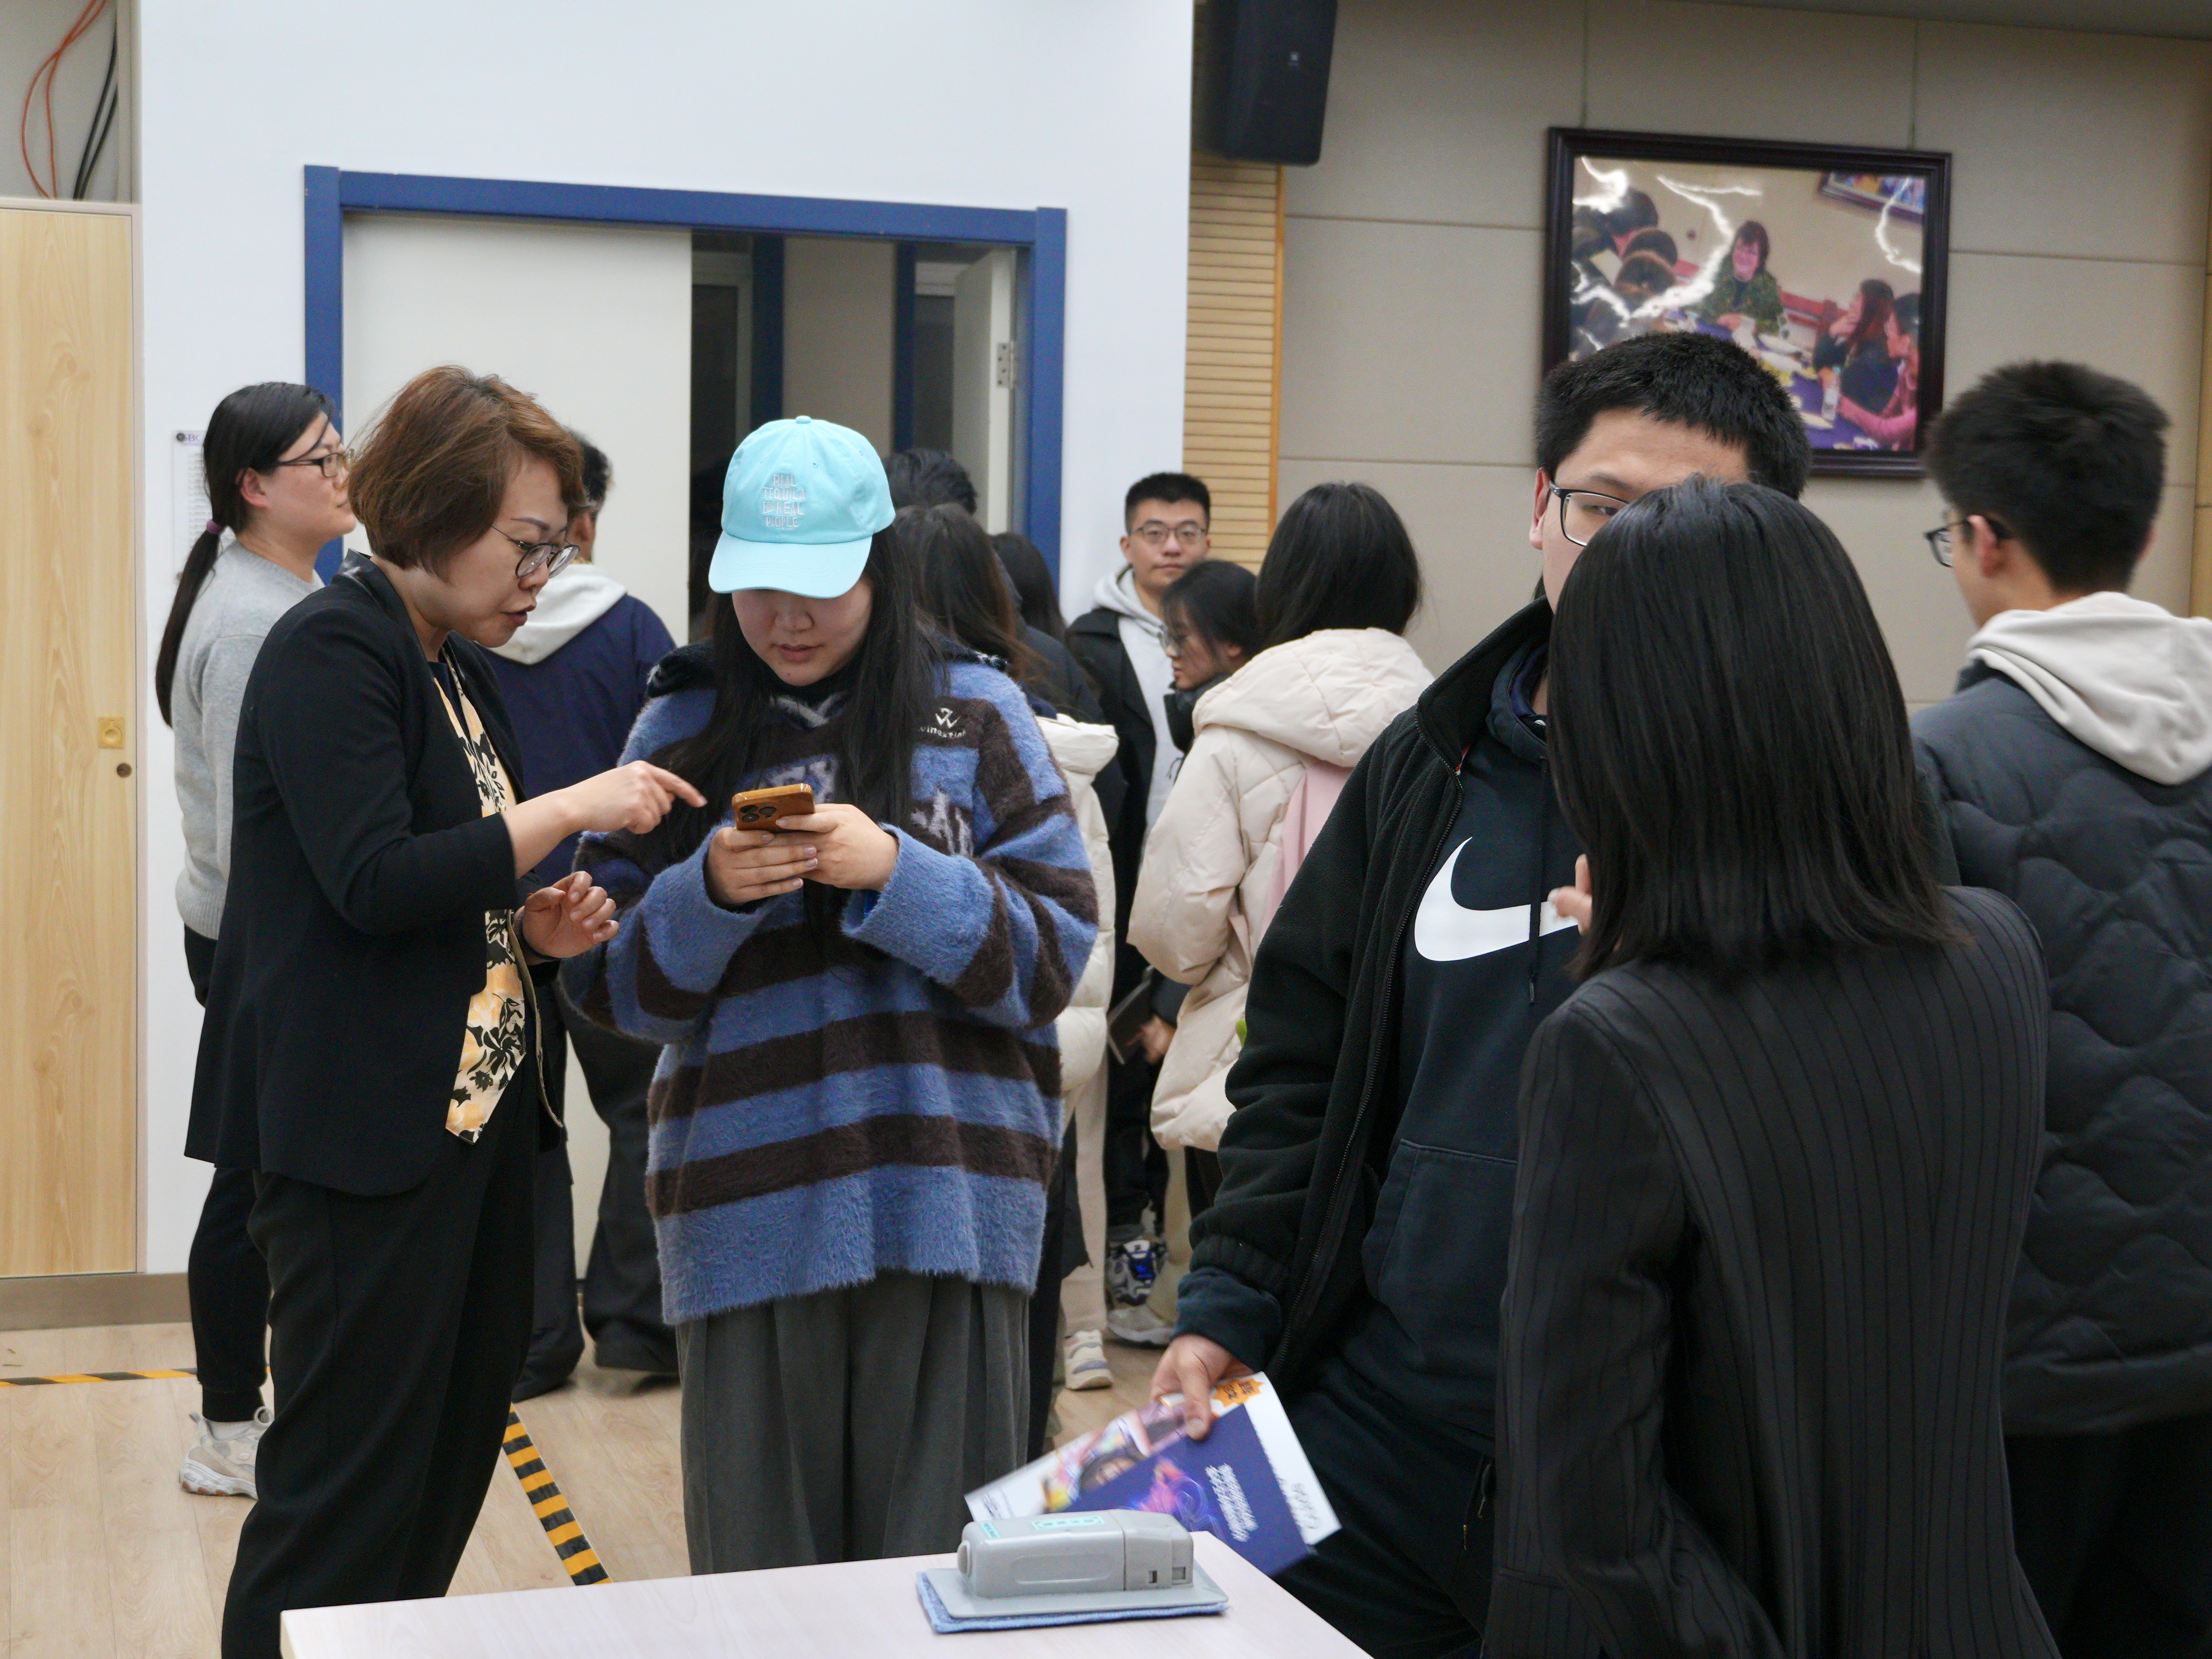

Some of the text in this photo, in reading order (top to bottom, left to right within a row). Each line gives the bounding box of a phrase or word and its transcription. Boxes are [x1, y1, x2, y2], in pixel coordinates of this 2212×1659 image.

[773, 474, 797, 486] REAL
[763, 487, 805, 500] TEQUILA
[762, 501, 804, 515] FOR REAL
[766, 516, 798, 528] PEOPLE
